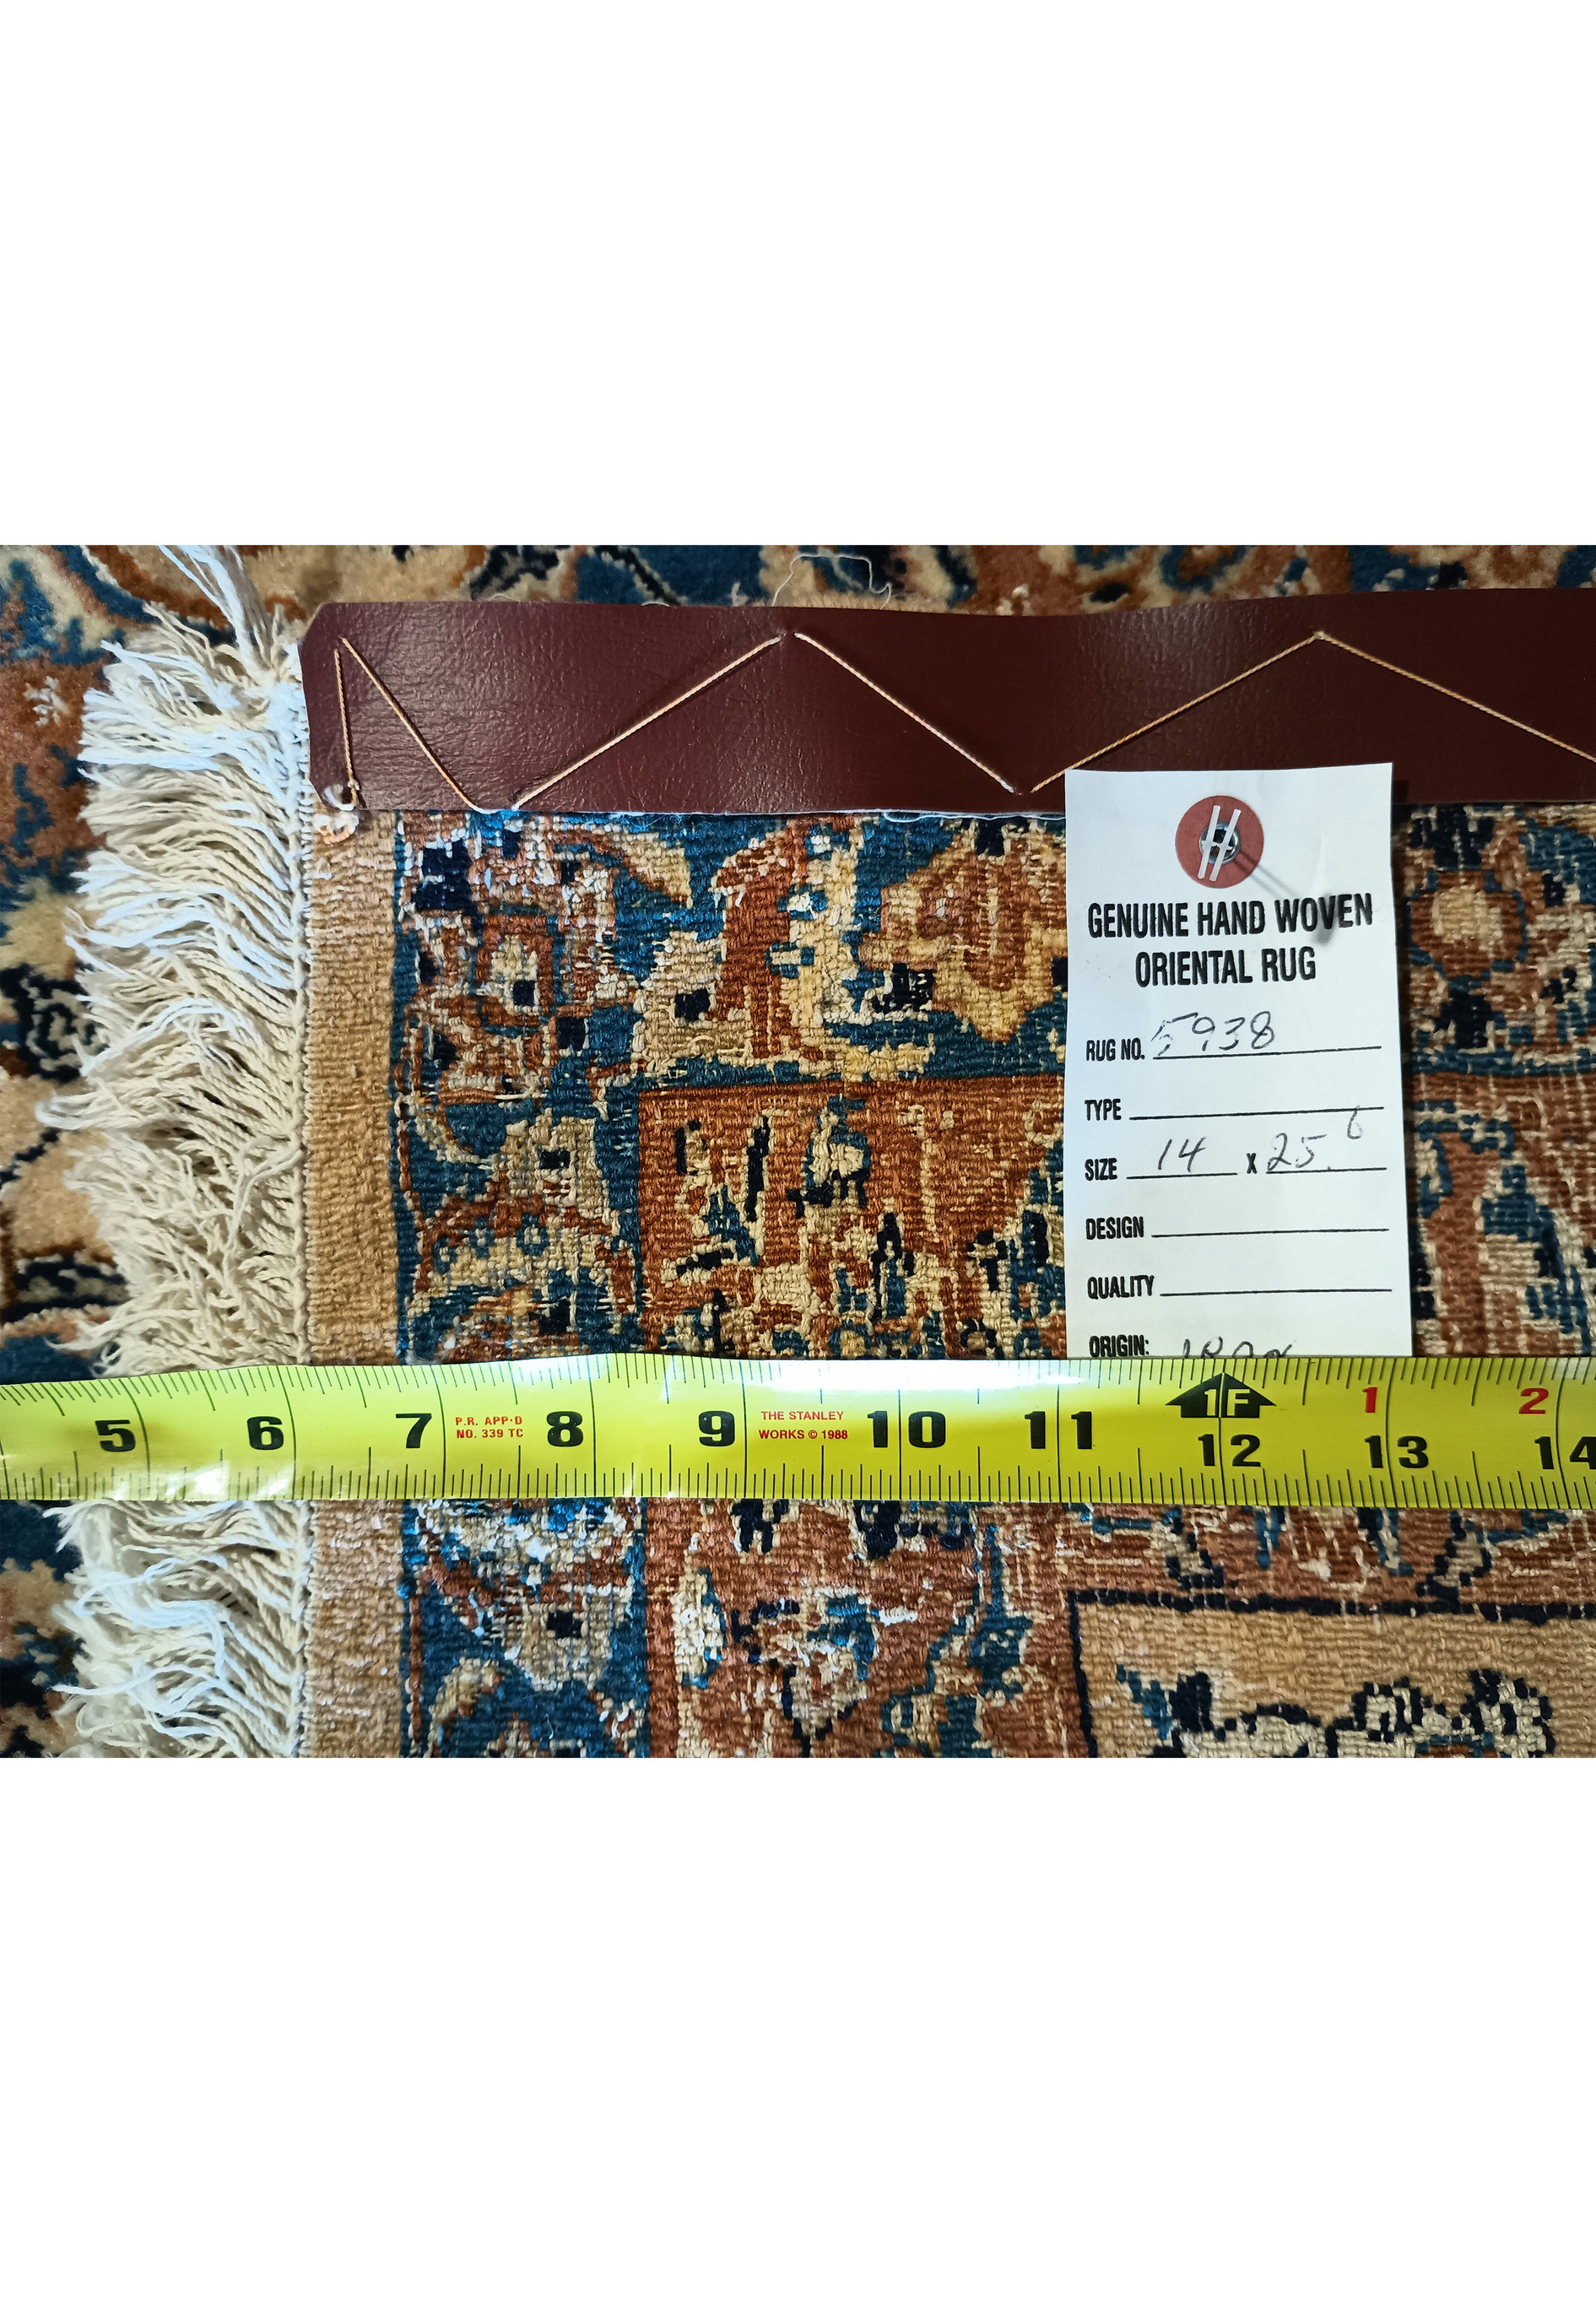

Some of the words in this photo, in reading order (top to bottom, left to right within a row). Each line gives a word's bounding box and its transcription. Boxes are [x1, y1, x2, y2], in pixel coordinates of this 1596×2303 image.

[1087, 901, 1189, 938] GENUINE
[1197, 900, 1266, 936] HAND
[1274, 893, 1373, 933] WOVEN
[1135, 950, 1253, 987] ORIENTAL
[1261, 946, 1317, 982] RUG
[1085, 1040, 1117, 1062] RUG
[1120, 1037, 1145, 1061] NO.
[1151, 1011, 1275, 1057] 5938
[1085, 1099, 1123, 1121] TYPE
[1085, 1158, 1117, 1181] SIZE
[1157, 1136, 1206, 1173] 14
[1085, 1216, 1144, 1240] DESIGN
[1087, 1275, 1155, 1299] QUALITY
[1089, 1334, 1150, 1357] ORIGIN:
[760, 1411, 785, 1420] THE
[789, 1410, 845, 1421] STANLEY
[1363, 1387, 1378, 1414] 1
[1518, 1387, 1550, 1415] 2
[95, 1419, 136, 1452] 5
[246, 1416, 284, 1451] 6
[395, 1413, 432, 1449] 7
[455, 1417, 479, 1426] P.R.
[456, 1429, 479, 1439] NO.
[482, 1429, 505, 1439] 339
[508, 1428, 524, 1438] TC
[546, 1410, 584, 1447] 8
[698, 1410, 736, 1447] 9
[758, 1429, 805, 1440] WORKS
[821, 1429, 848, 1440] 1988
[867, 1410, 947, 1449] 10
[1024, 1410, 1093, 1450] 11
[1198, 1433, 1262, 1468] 12
[1364, 1435, 1430, 1469] 13
